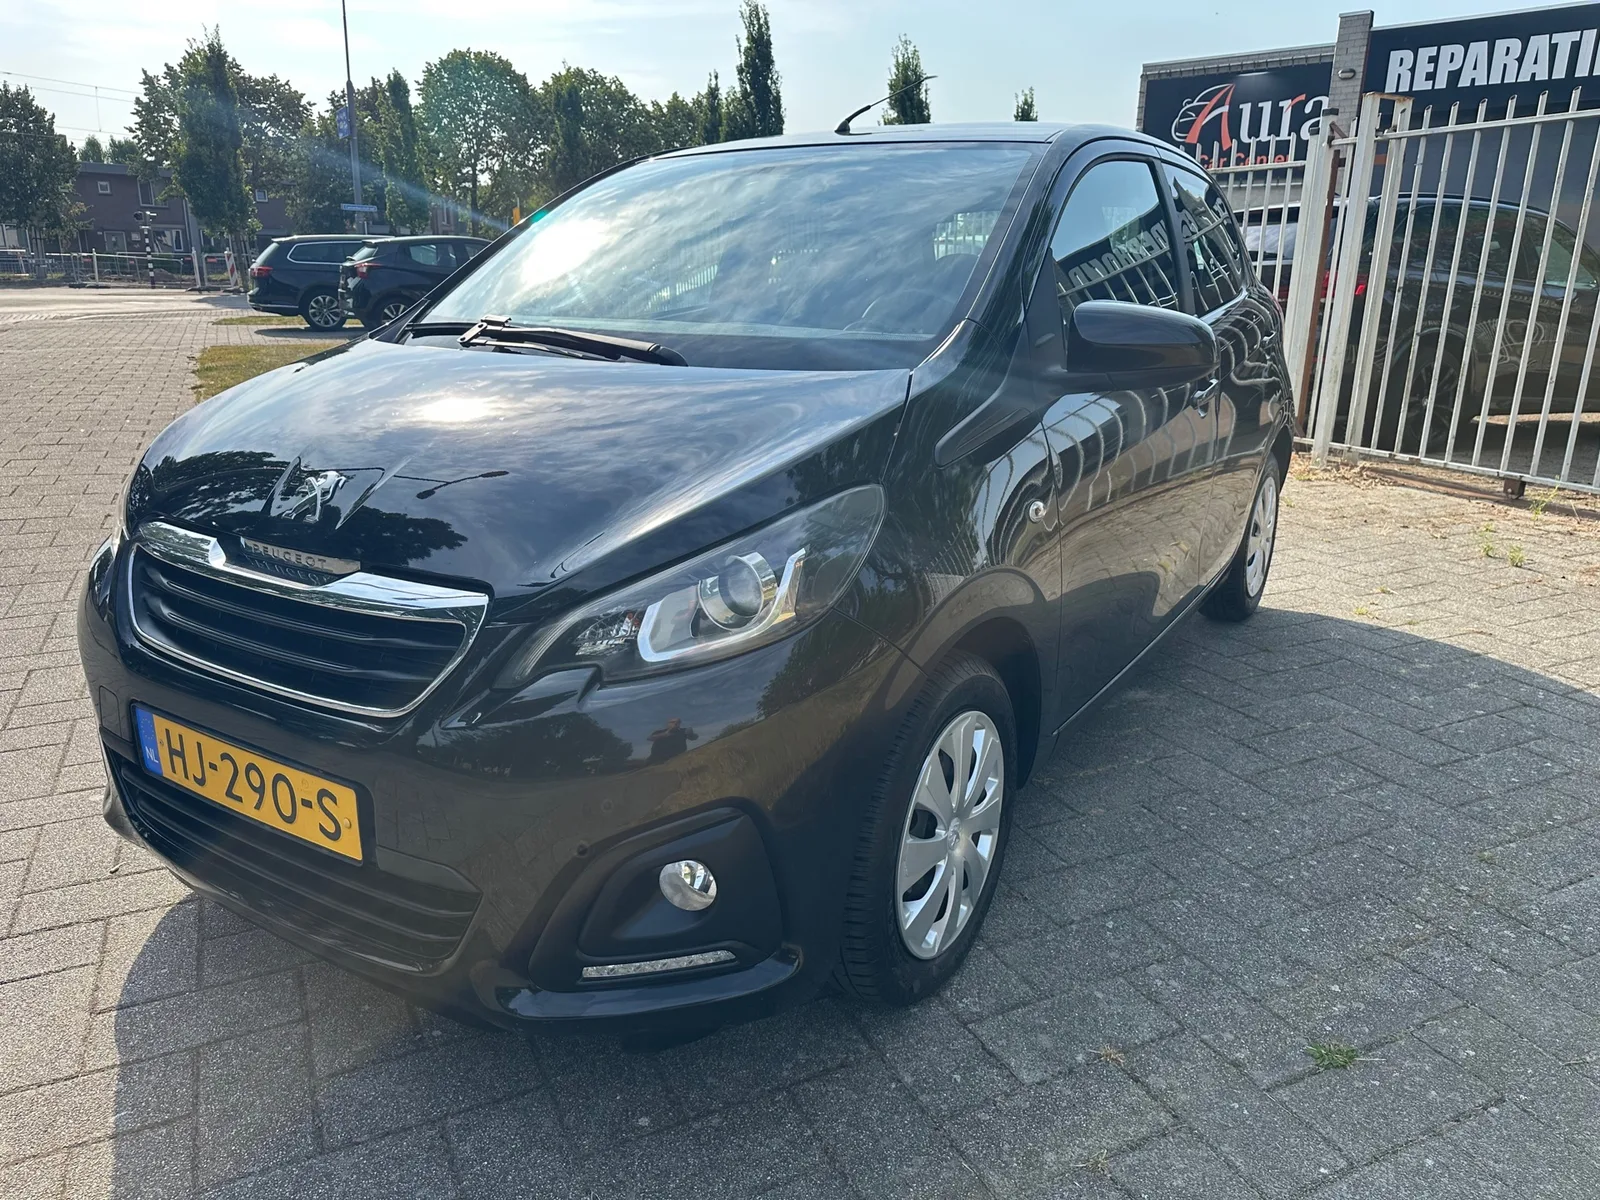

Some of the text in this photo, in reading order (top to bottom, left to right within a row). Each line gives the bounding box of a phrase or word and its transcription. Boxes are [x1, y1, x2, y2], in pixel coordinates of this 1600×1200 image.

[1385, 28, 1600, 94] REPARATI
[252, 543, 327, 569] PEUGEOT
[145, 745, 159, 763] NL
[164, 728, 342, 842] HJ-290-S
